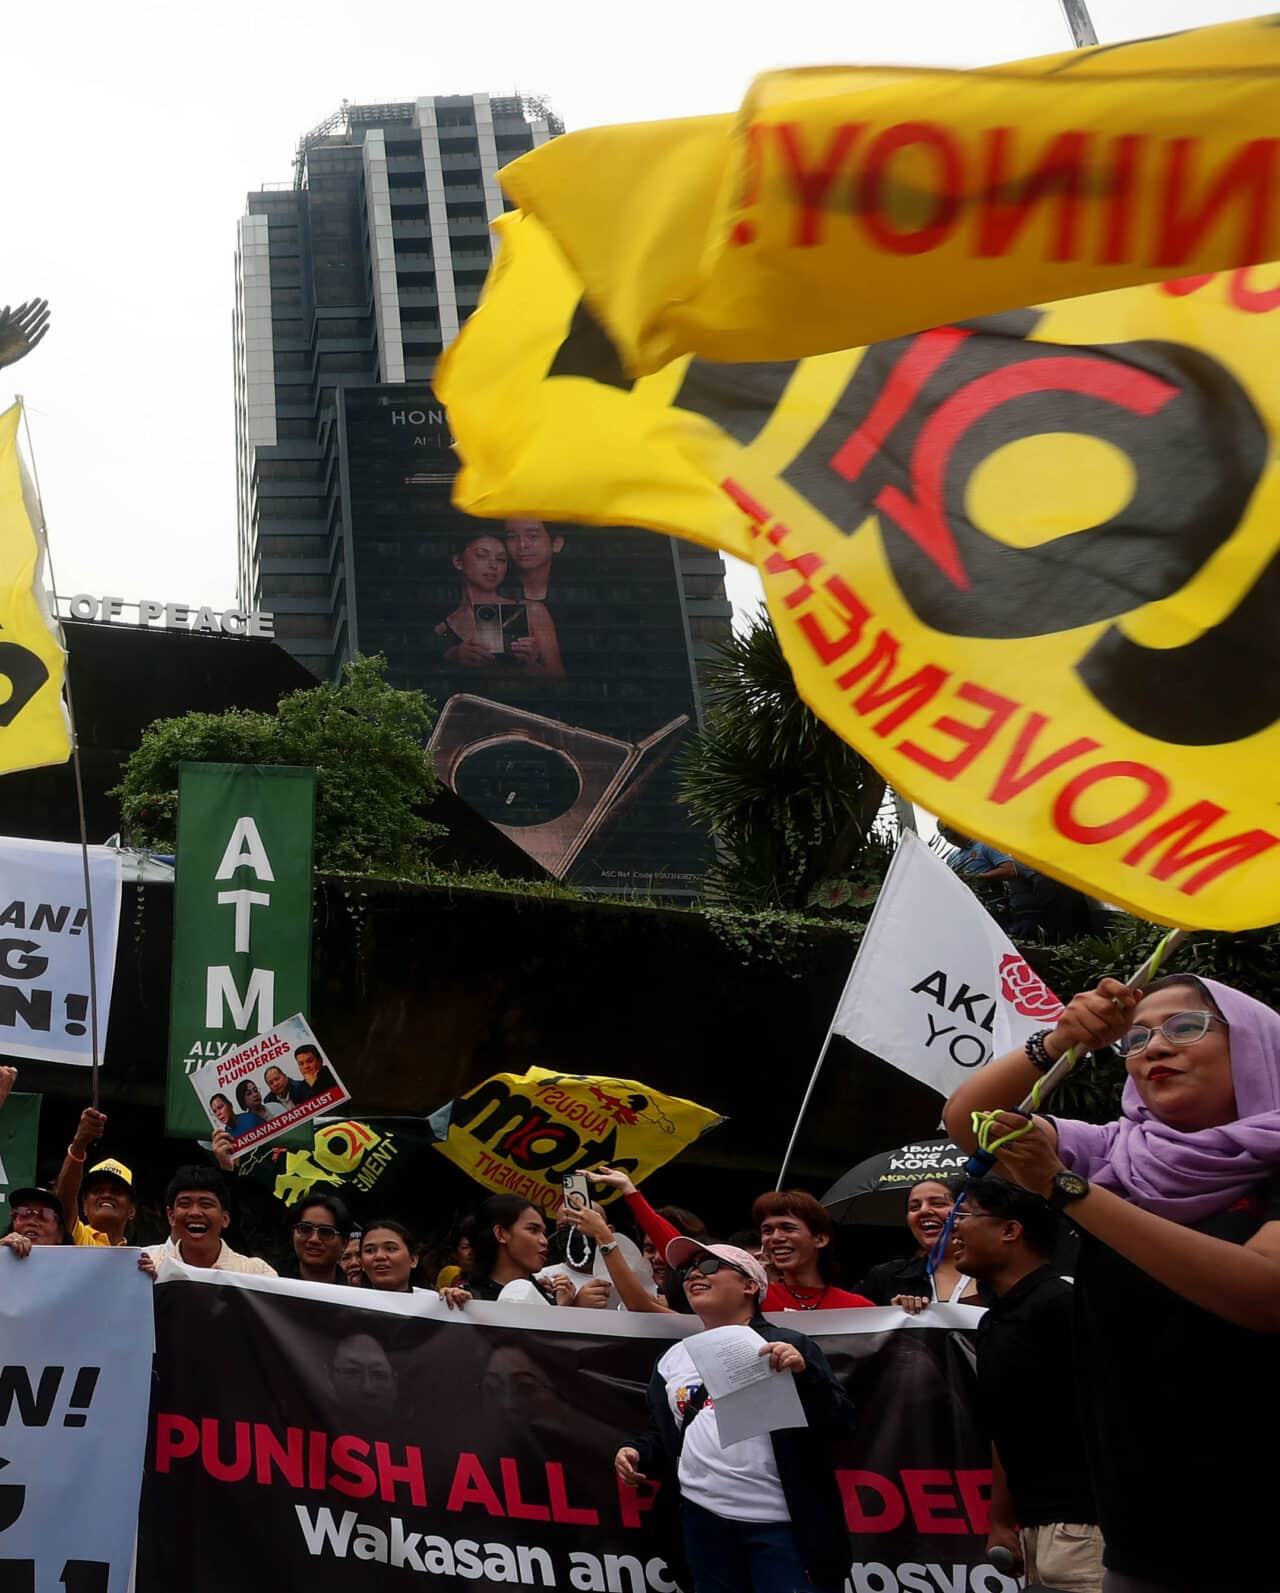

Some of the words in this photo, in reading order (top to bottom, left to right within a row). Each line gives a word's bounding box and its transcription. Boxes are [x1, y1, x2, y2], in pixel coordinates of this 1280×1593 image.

[392, 409, 449, 425] HON
[70, 594, 125, 623] OF
[139, 601, 275, 638] PEACE
[206, 817, 275, 1033] ATM
[216, 1045, 259, 1075] PUNISH
[261, 1034, 281, 1051] ALL
[218, 1042, 291, 1088] PLUNDERERS
[237, 1118, 281, 1148] AKBAYAN
[281, 1092, 333, 1126] PARTYLIST
[156, 1413, 427, 1508] PUNISH
[447, 1452, 599, 1527] ALL
[294, 1504, 556, 1588] Wakasan
